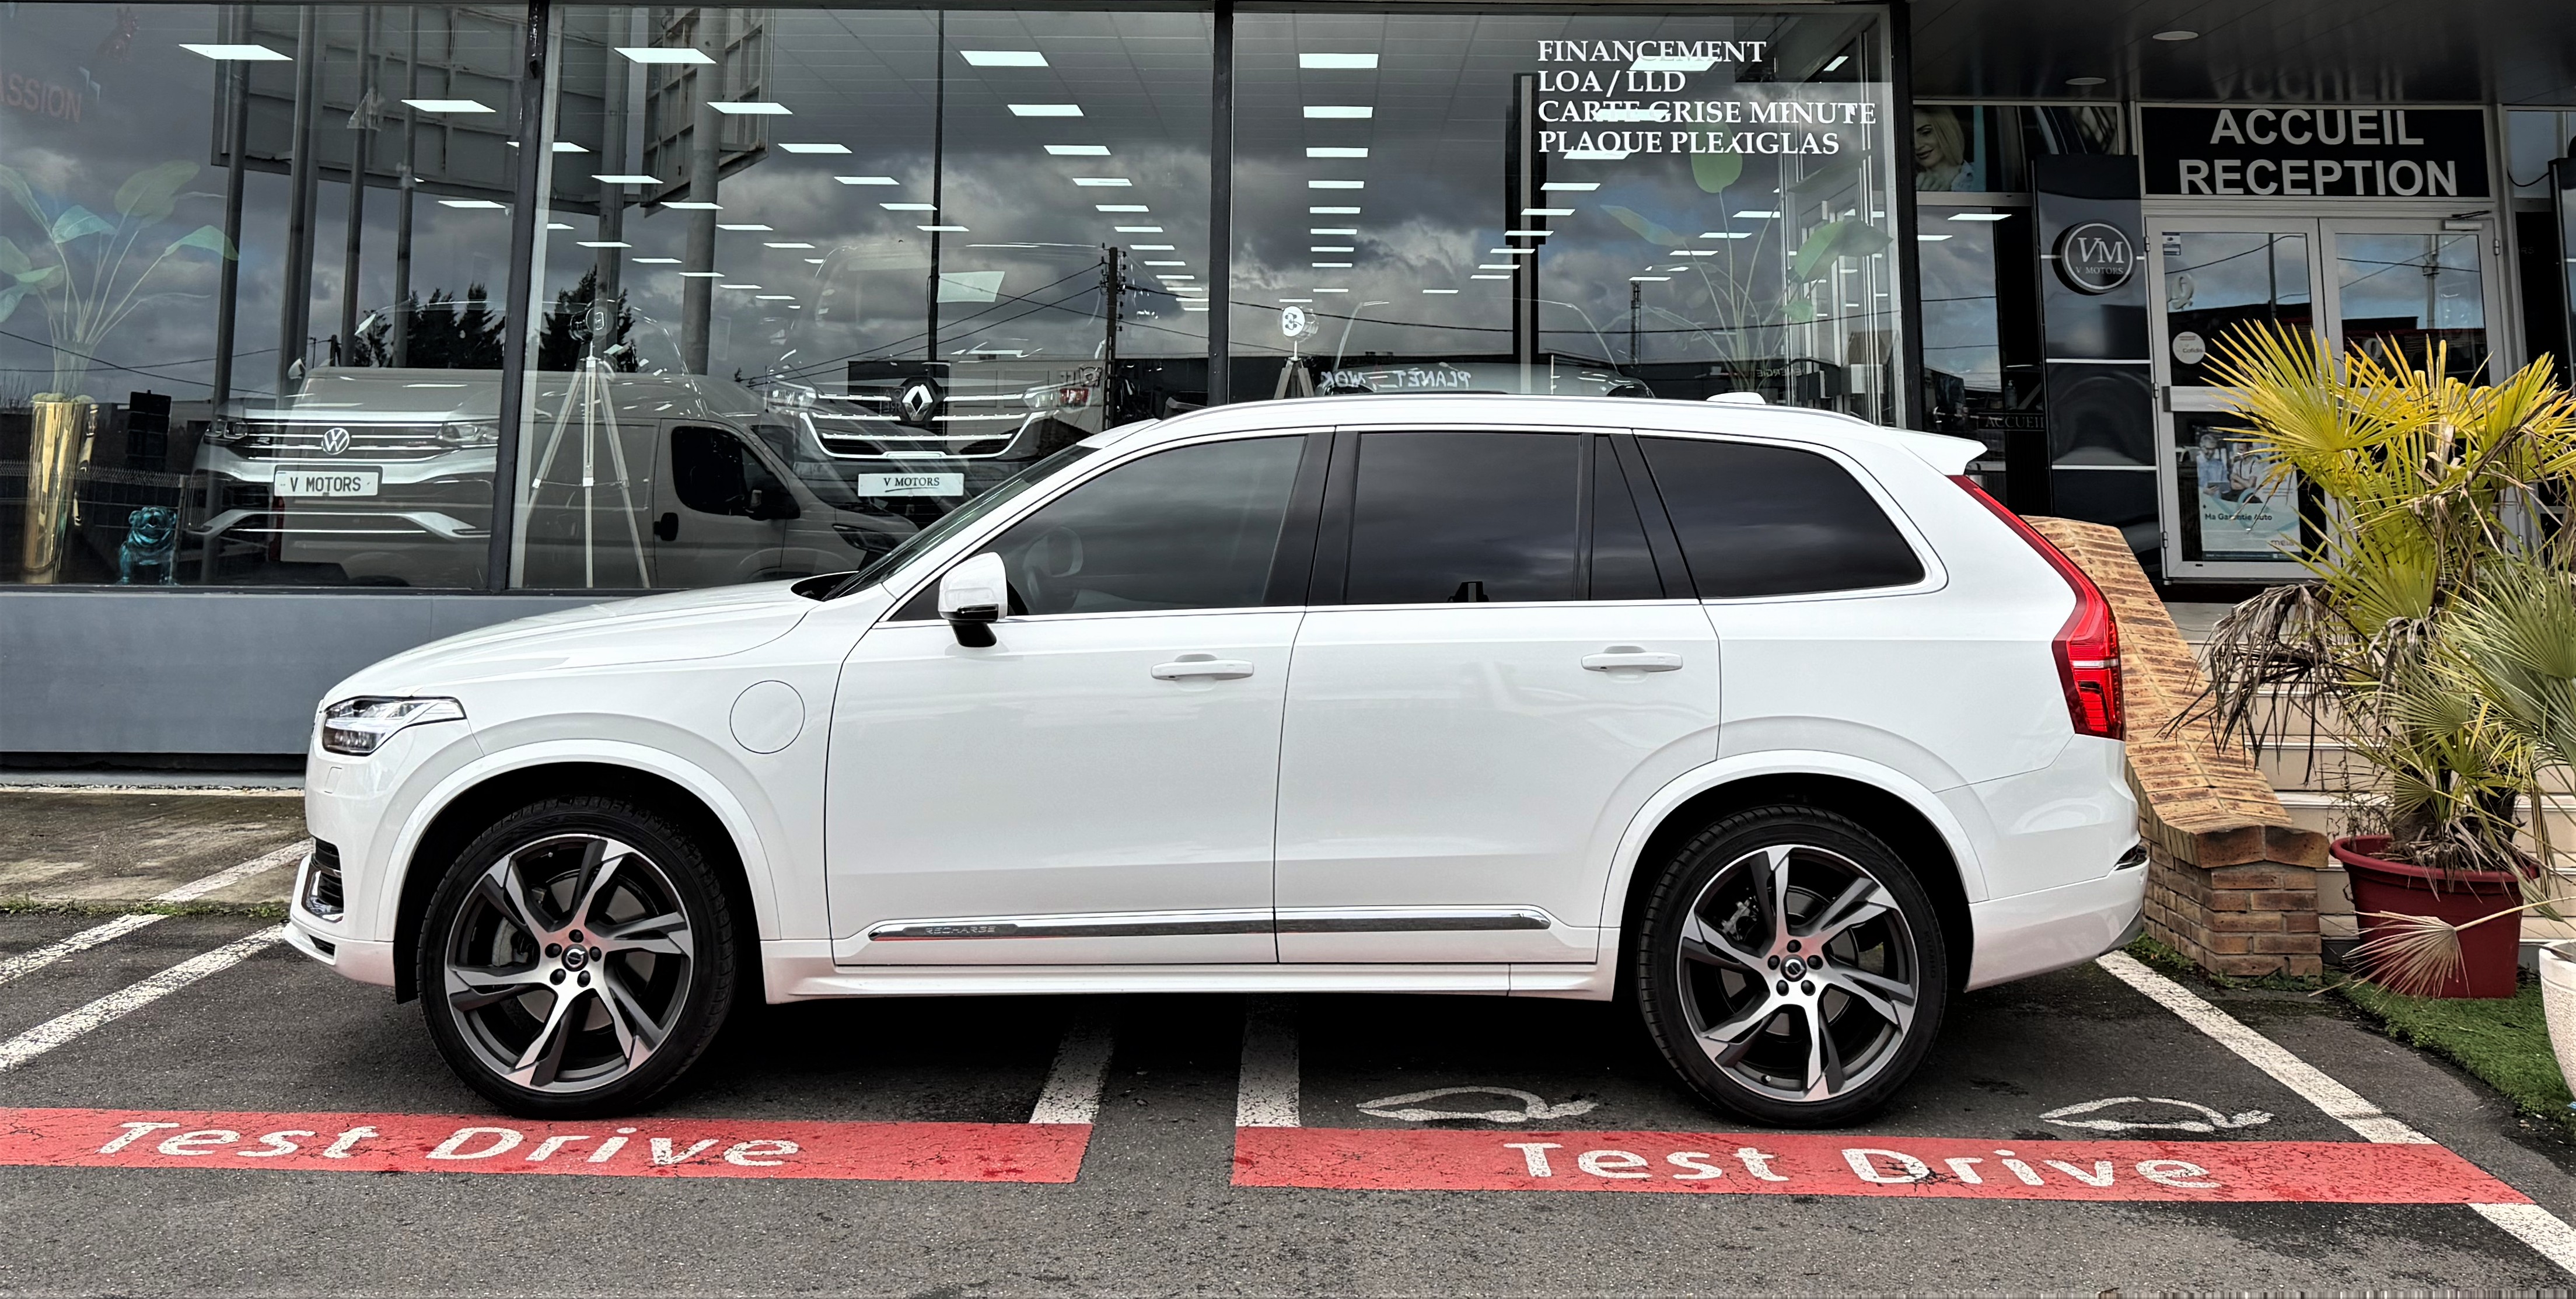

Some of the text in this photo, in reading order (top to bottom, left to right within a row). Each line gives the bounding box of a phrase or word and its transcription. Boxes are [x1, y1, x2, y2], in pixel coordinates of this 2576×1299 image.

[1537, 40, 1767, 62] FINANCEMENT
[1537, 70, 1603, 92] LOA
[1626, 71, 1686, 92] LLD
[1538, 100, 1876, 124] CARTE GRISE MINUTE
[2209, 109, 2424, 145] ACCUEIL
[1539, 131, 1839, 155] PLAQUE PLEXIGLAS
[2178, 159, 2458, 196] RECEPTION
[2077, 237, 2125, 264] VM
[2085, 267, 2124, 275] MOTORS
[290, 476, 362, 492] V MOTORS
[883, 477, 940, 487] V MOTORS
[2204, 512, 2217, 521] Ma
[94, 1122, 799, 1166] Test Drive
[1503, 1142, 2222, 1189] Test Drive
